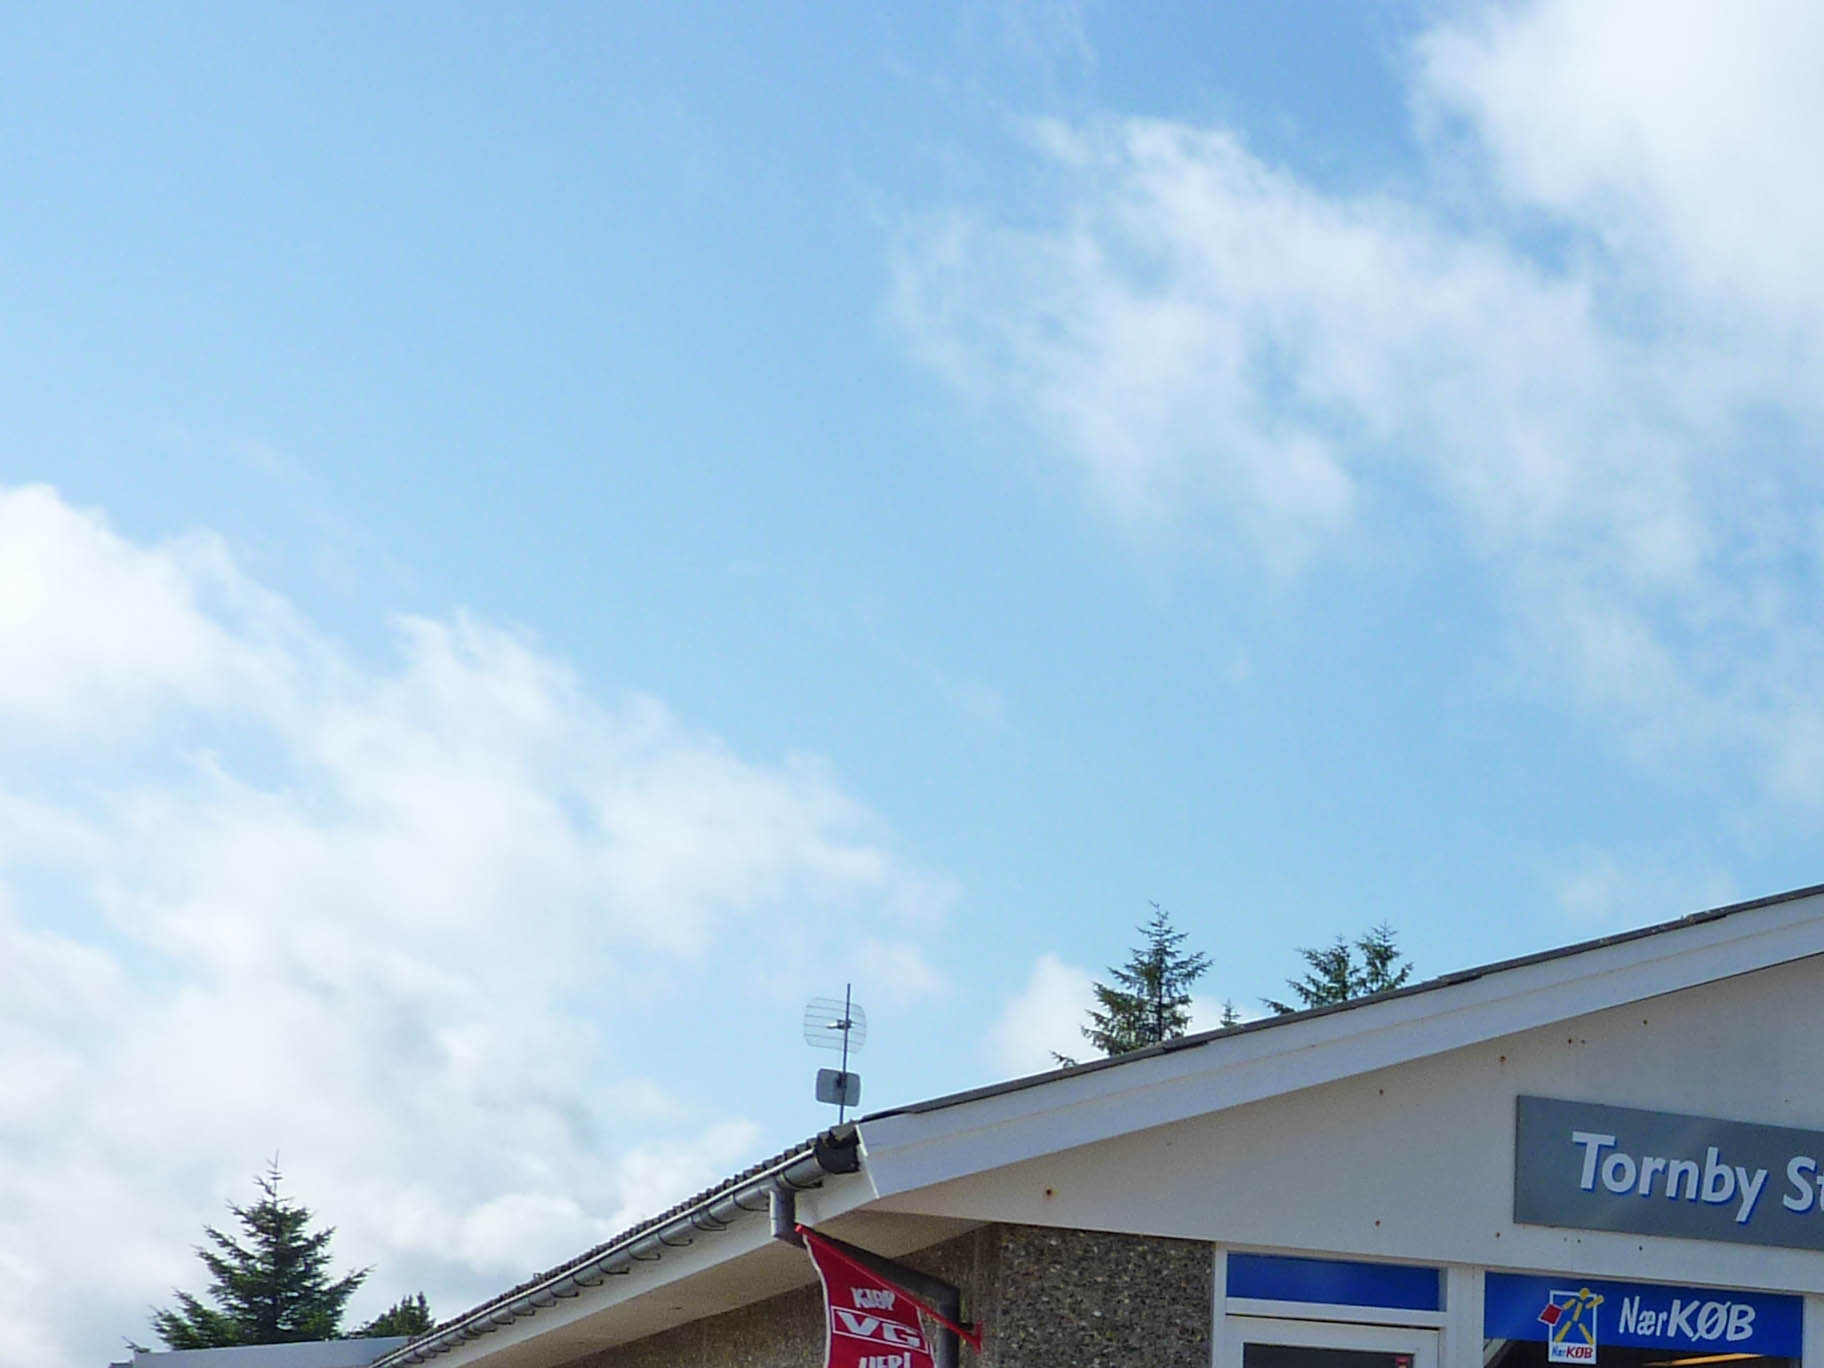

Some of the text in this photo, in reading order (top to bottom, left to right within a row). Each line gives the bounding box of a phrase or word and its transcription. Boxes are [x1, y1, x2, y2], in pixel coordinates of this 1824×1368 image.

[1572, 1131, 1767, 1224] Tornby
[836, 1310, 921, 1348] VG
[1618, 1295, 1756, 1342] NærKØB
